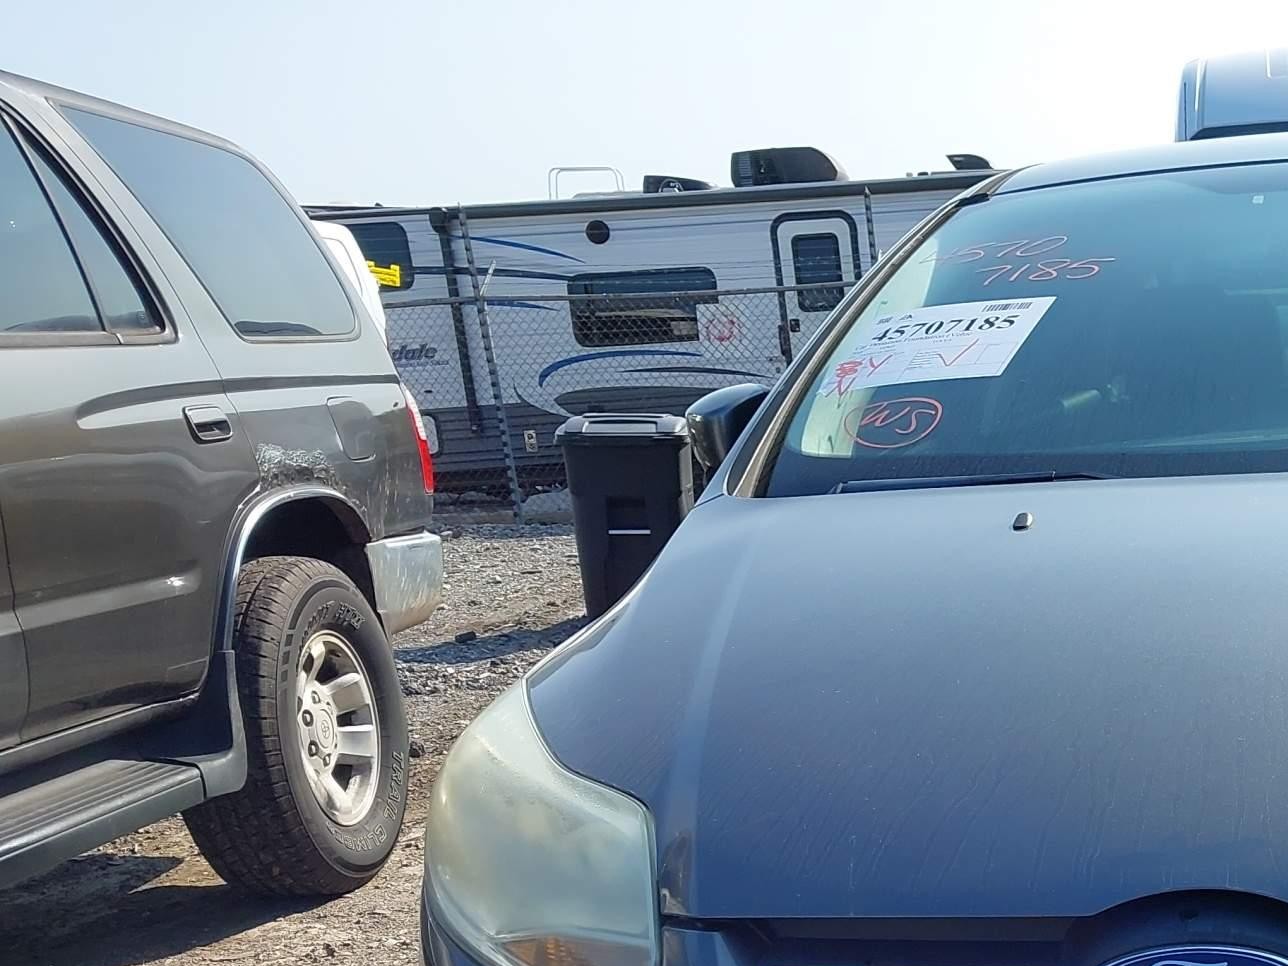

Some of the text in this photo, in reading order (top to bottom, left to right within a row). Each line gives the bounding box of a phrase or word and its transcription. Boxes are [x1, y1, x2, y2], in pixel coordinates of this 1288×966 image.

[976, 257, 1116, 286] 7185
[871, 314, 1020, 342] 45707185
[384, 751, 405, 820] TRAIL
